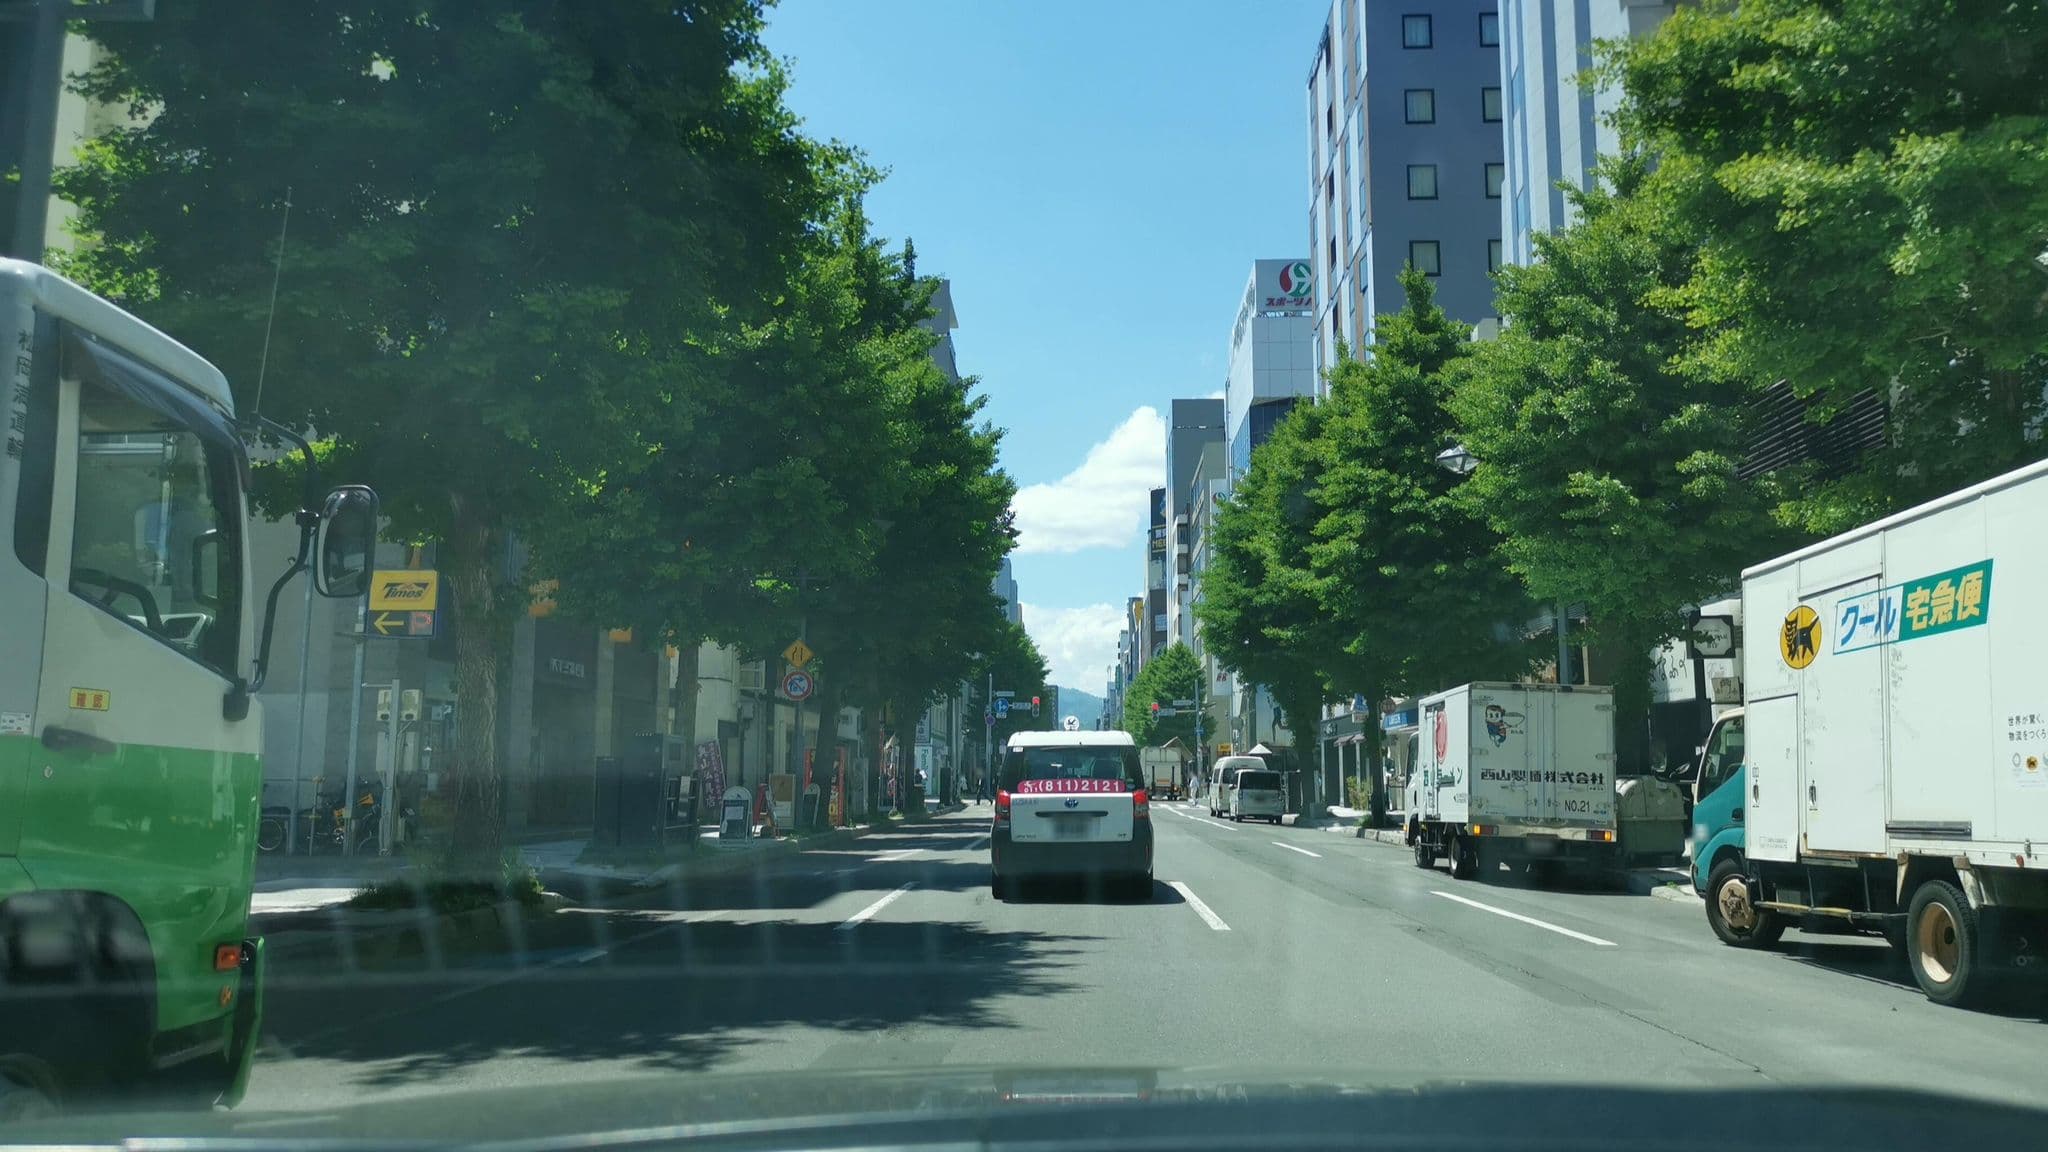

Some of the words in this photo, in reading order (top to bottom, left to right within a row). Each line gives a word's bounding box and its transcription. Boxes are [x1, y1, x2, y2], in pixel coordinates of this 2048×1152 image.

[383, 582, 429, 600] Times
[1840, 596, 1897, 646] クール
[1905, 569, 1984, 631] 宅急便
[1039, 780, 1119, 792] (811)2121
[1564, 799, 1591, 812] NO.21
